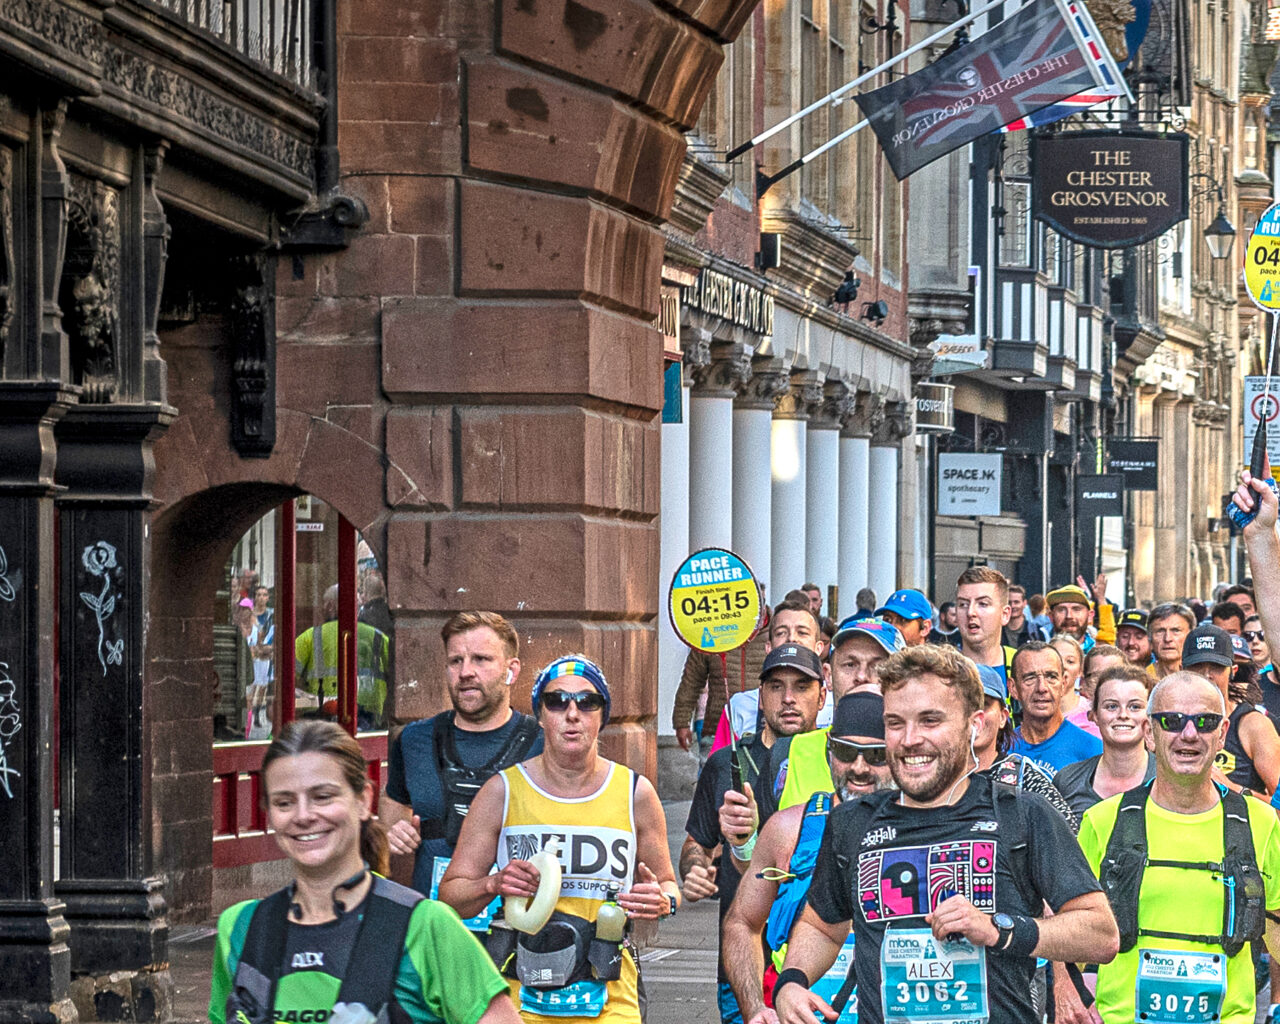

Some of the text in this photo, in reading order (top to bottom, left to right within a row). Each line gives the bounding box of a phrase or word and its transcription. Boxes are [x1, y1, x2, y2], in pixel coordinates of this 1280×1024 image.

[1090, 151, 1132, 166] THE
[1067, 171, 1153, 186] CHESTER
[1051, 191, 1169, 207] GROSVENOR
[701, 268, 733, 320] CHESTER
[947, 484, 990, 495] apothecary
[690, 556, 730, 572] PACE
[681, 567, 742, 586] RUNNER
[681, 590, 750, 616] 04:15
[693, 616, 712, 624] pace
[720, 611, 742, 620] 09:43
[1196, 641, 1216, 649] GOAT
[889, 938, 919, 948] mbna
[1147, 957, 1174, 966] mbna
[908, 961, 952, 978] ALEX
[536, 990, 591, 1004] 1541
[896, 980, 968, 1003] 3062
[1149, 993, 1208, 1013] 3075
